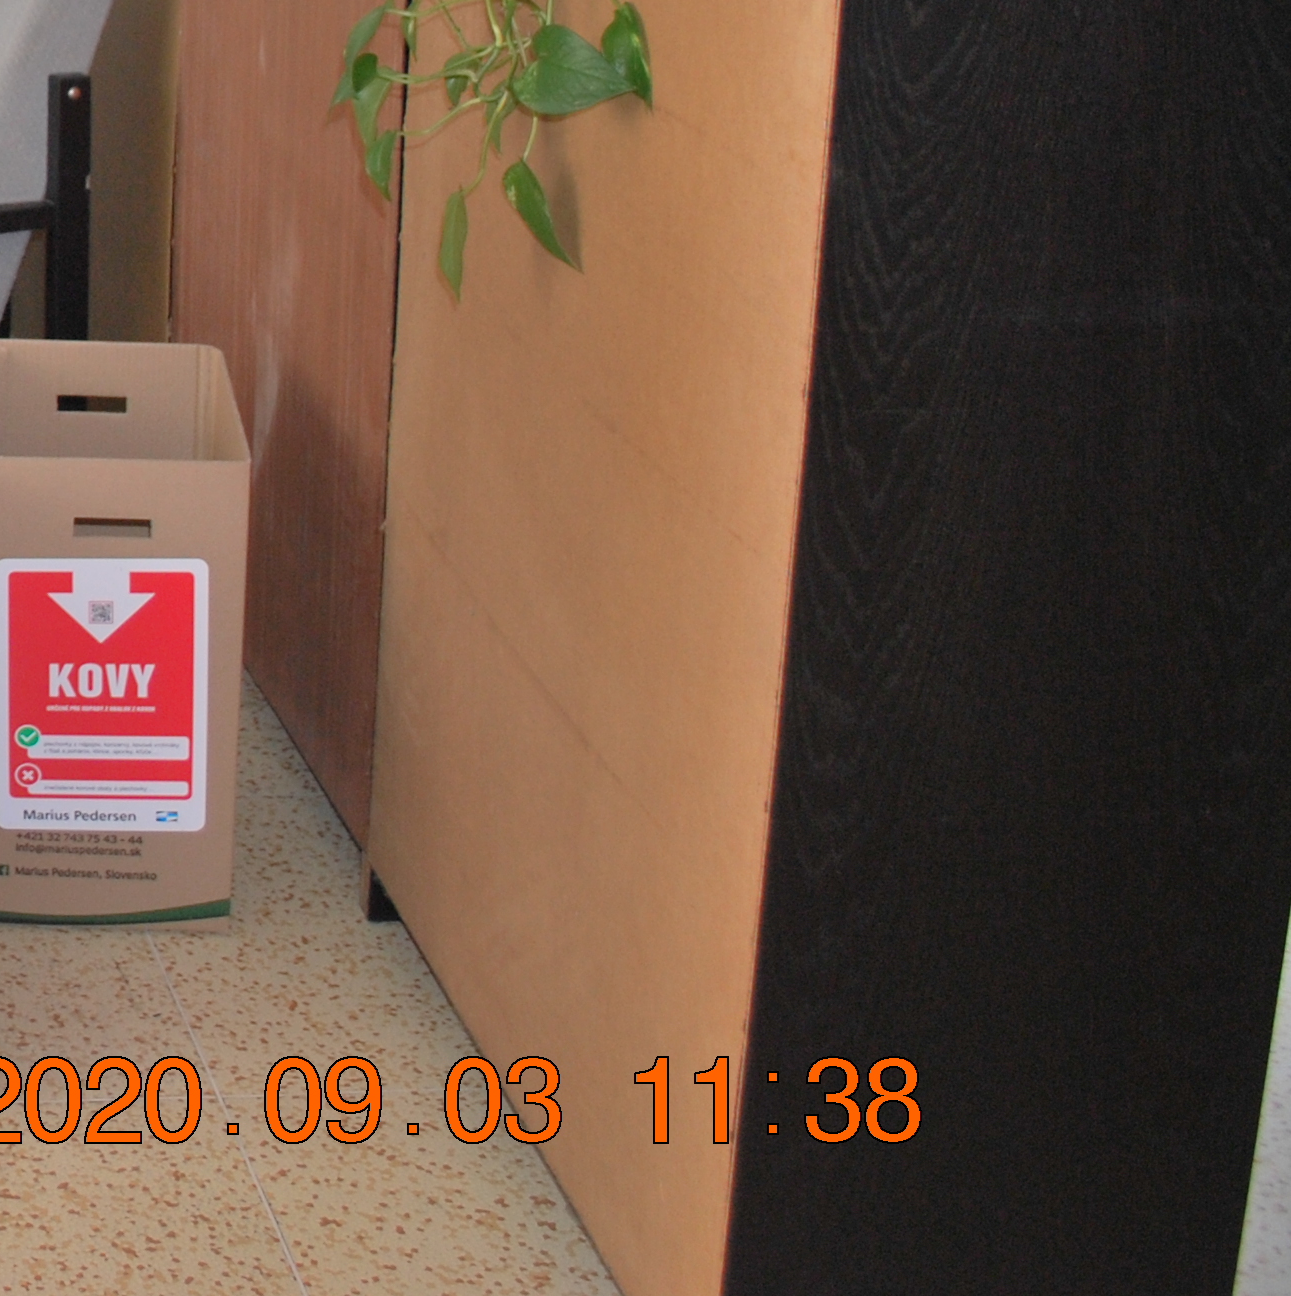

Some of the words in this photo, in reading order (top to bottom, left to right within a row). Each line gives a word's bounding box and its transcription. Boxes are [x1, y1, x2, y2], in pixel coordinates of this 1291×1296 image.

[47, 662, 156, 698] KOVY
[23, 809, 70, 821] Marius
[74, 810, 137, 822] Pedersen
[47, 832, 61, 842] 32
[63, 833, 84, 843] 743
[87, 833, 101, 843] 75
[102, 834, 118, 843] 43
[127, 835, 143, 844] 44
[15, 866, 49, 877] Marius
[105, 869, 158, 881] Slovensko
